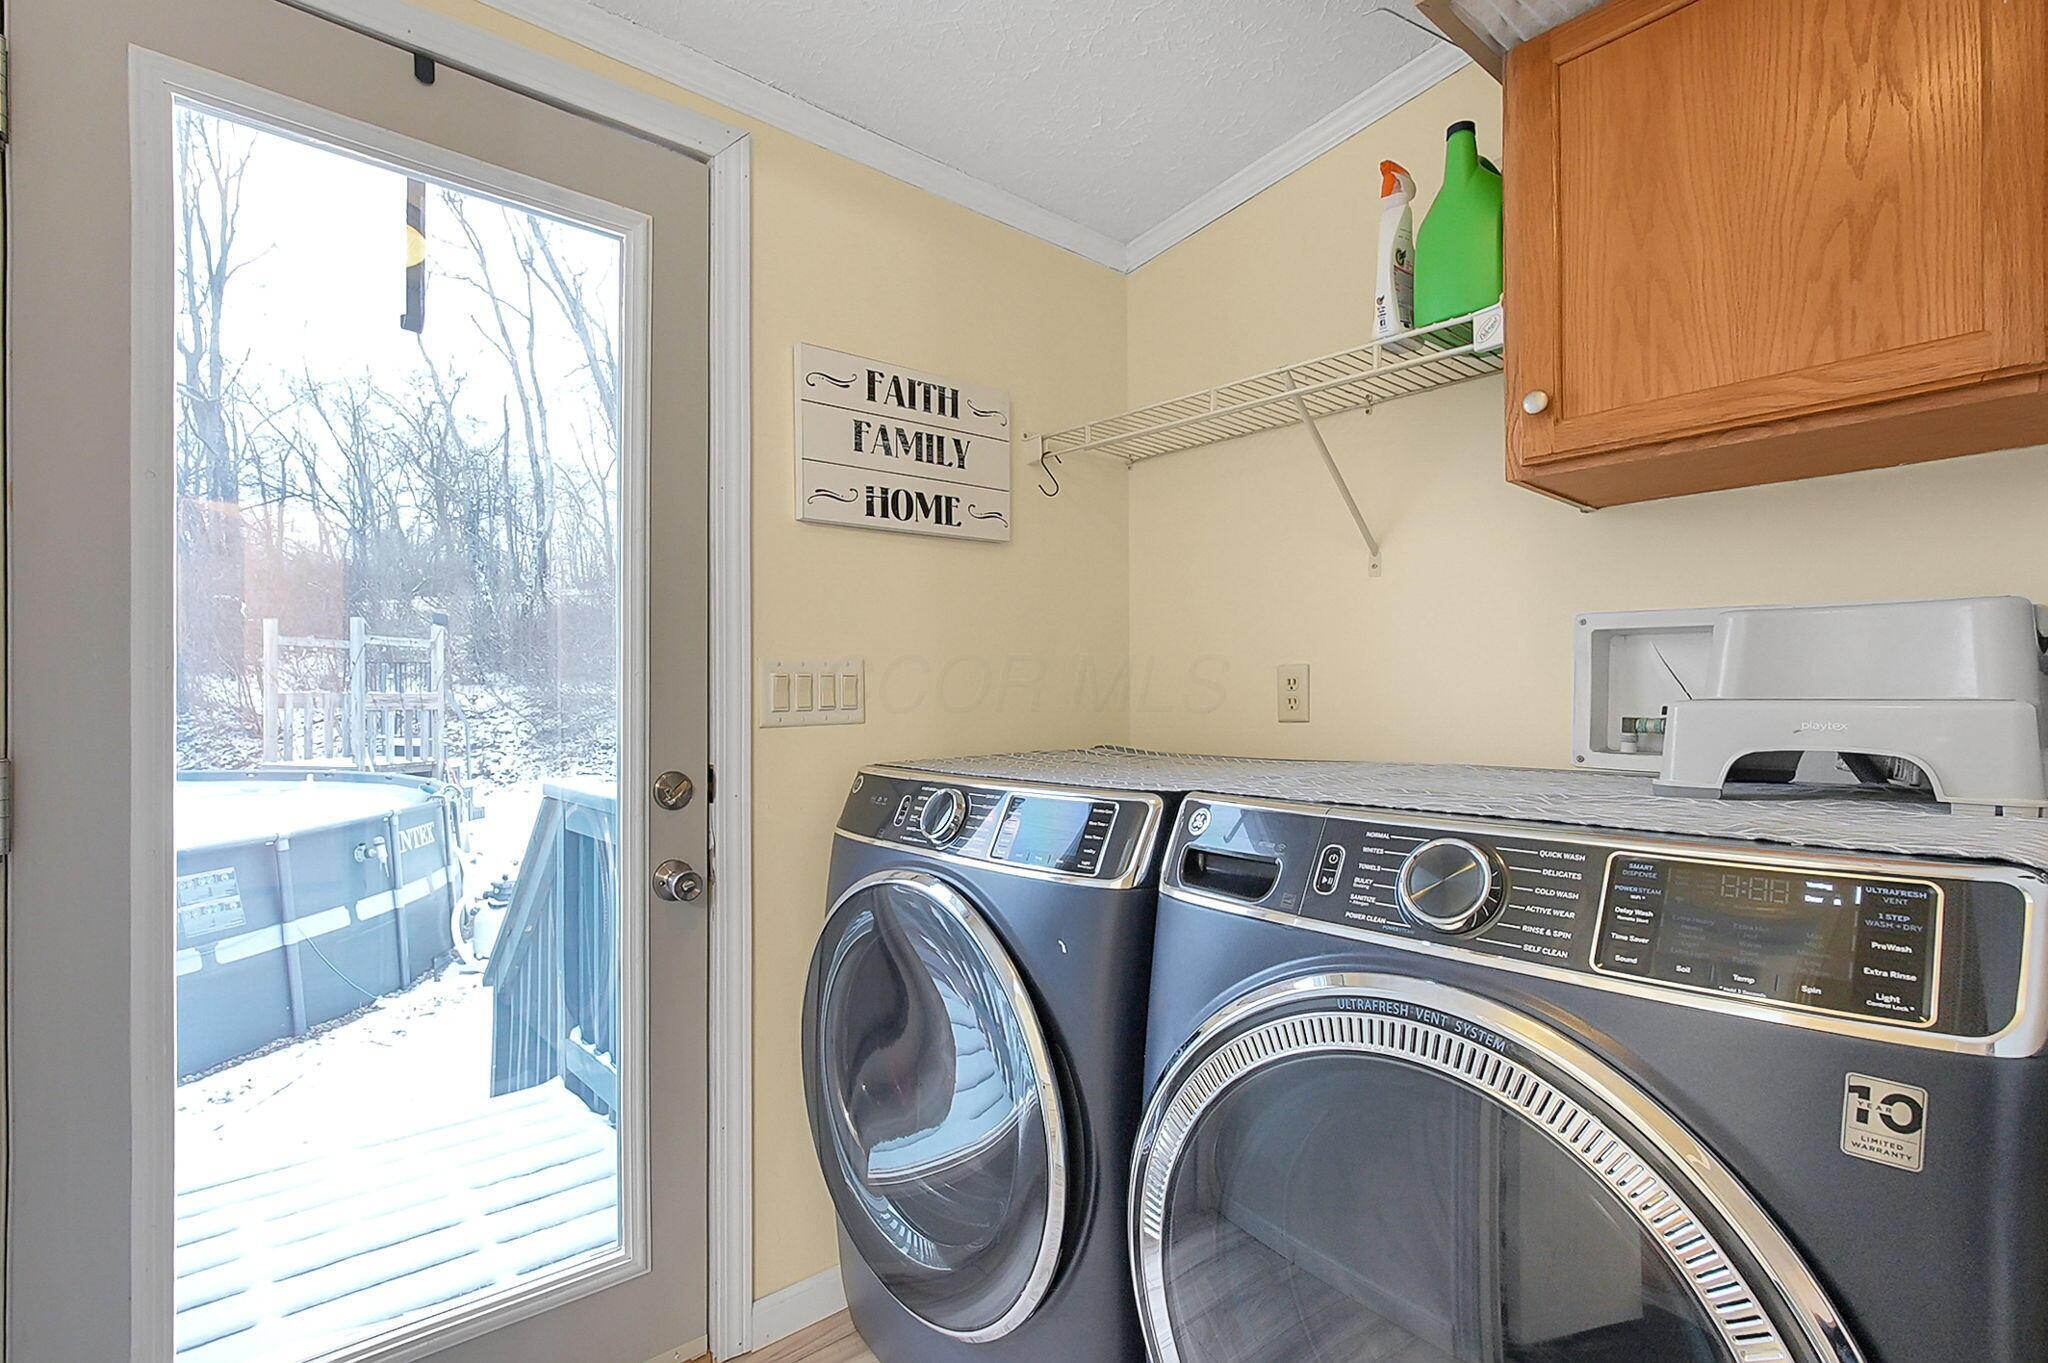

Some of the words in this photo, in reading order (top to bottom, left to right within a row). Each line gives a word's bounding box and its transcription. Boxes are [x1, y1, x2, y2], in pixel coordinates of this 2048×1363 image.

[866, 369, 960, 419] FAITH
[853, 419, 971, 470] FAMILY
[865, 486, 962, 528] HOME
[1801, 720, 1848, 731] playtex
[399, 821, 435, 853] NTEX
[1366, 831, 1390, 839] NORMAL
[1362, 846, 1384, 854] WHITES
[1539, 850, 1563, 859] QUICK
[1563, 852, 1586, 862] WASH
[1358, 863, 1381, 871] TOWELS
[1628, 862, 1654, 871] SMART
[1353, 877, 1374, 885] BULKY
[1542, 868, 1582, 881] DELICATES
[1350, 893, 1376, 903] SANITIZE
[1534, 887, 1556, 897] COLD
[1556, 890, 1580, 900] WASH
[1865, 886, 1928, 899] ULTRAFRESH
[1882, 896, 1908, 905] VENT
[1345, 911, 1366, 920] POWER
[1366, 914, 1387, 924] CLEAN
[1525, 904, 1552, 916] ACTIVE
[1552, 909, 1576, 919] WEAR
[1614, 906, 1634, 916] Delay
[1634, 908, 1654, 918] Wash
[1885, 914, 1911, 922] STEP
[1864, 919, 1894, 929] WASH
[1902, 922, 1924, 932] DRY
[1522, 925, 1544, 936] RINSE
[1545, 928, 1552, 936] &
[1552, 930, 1572, 940] SPIN
[1610, 932, 1628, 941] Time
[1523, 944, 1542, 954] SELF
[1542, 947, 1569, 958] CLEAN
[1870, 941, 1912, 954] PreWash
[1614, 954, 1638, 964] Sound
[1675, 965, 1691, 974] Soil
[1863, 966, 1888, 978] Extra
[1890, 970, 1918, 982] Rinse
[1732, 973, 1756, 985] Temp
[1801, 985, 1822, 996] Spin
[1876, 992, 1901, 1004] Light
[1337, 998, 1409, 1017] ULTRAFRESH
[1415, 1008, 1448, 1028] VENT
[1454, 1021, 1506, 1052] SYSTEM
[1857, 1100, 1893, 1114] YEAR
[1860, 1136, 1904, 1151] LIMITED
[1850, 1140, 1912, 1161] WARRANTY
